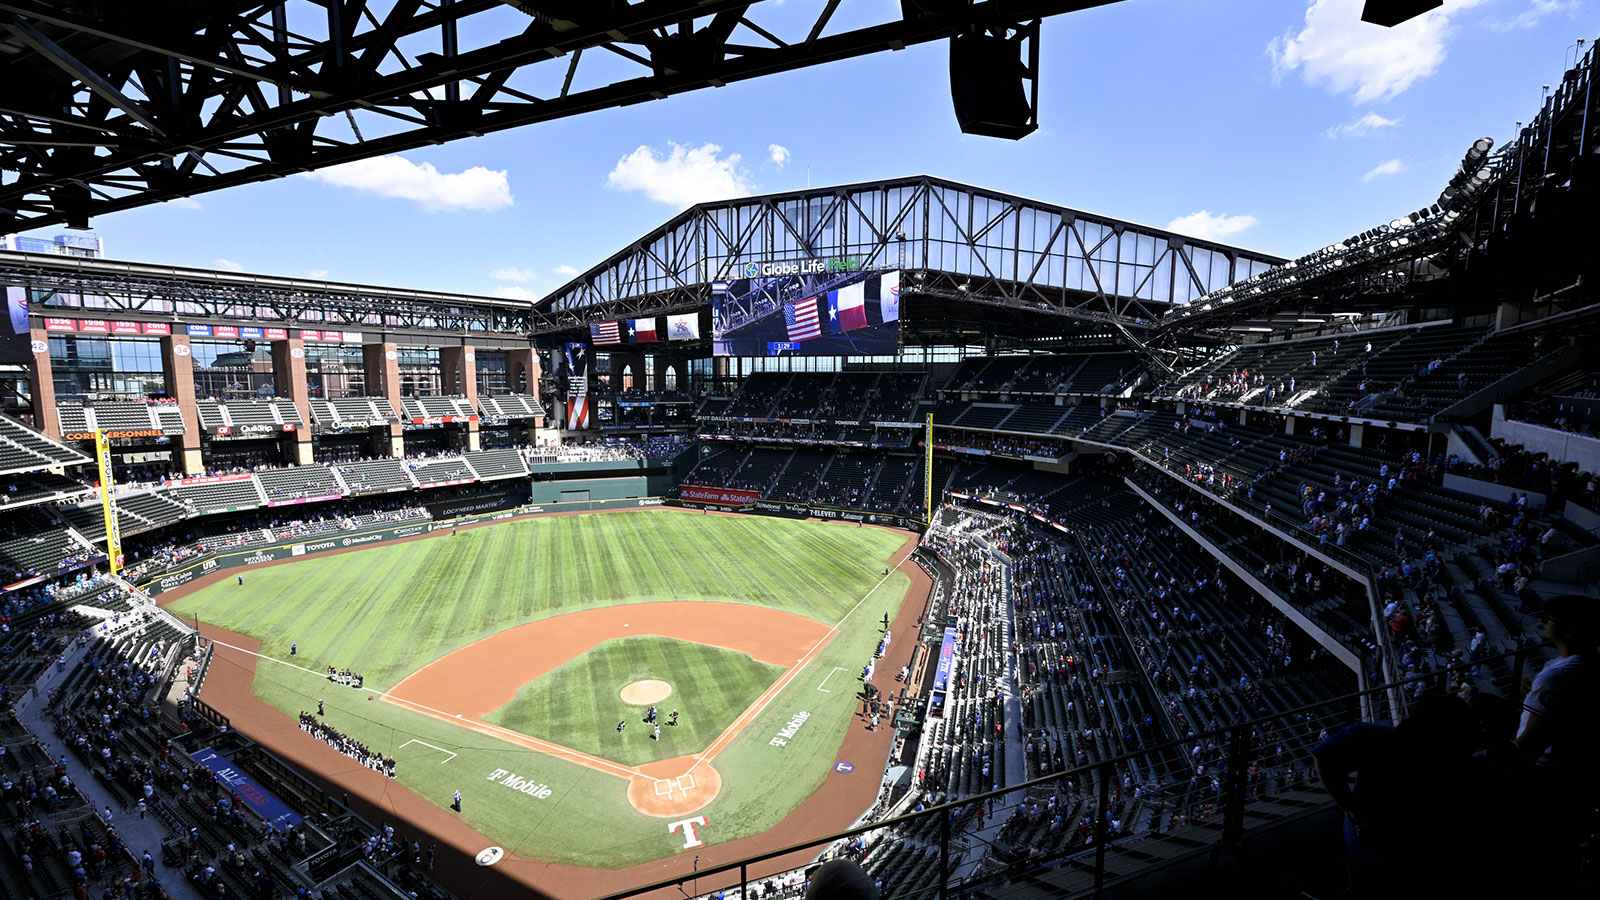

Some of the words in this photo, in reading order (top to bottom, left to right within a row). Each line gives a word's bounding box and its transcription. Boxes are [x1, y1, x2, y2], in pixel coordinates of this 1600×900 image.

[762, 262, 799, 276] Globe
[801, 259, 825, 273] Life
[828, 256, 859, 271] Field
[66, 432, 97, 440] CORE
[108, 430, 163, 438] ERSONNEL
[240, 425, 273, 433] QuikTrip
[442, 506, 475, 516] LOCKHEED
[475, 502, 498, 512] MARTIN
[809, 509, 837, 518] 7-ELEVEN
[306, 541, 336, 551] TOYOTA
[202, 560, 217, 570] UTA
[776, 710, 812, 740] Mobile
[499, 773, 553, 800] Mobile
[667, 815, 710, 850] T
[310, 848, 337, 866] TOYOTA
